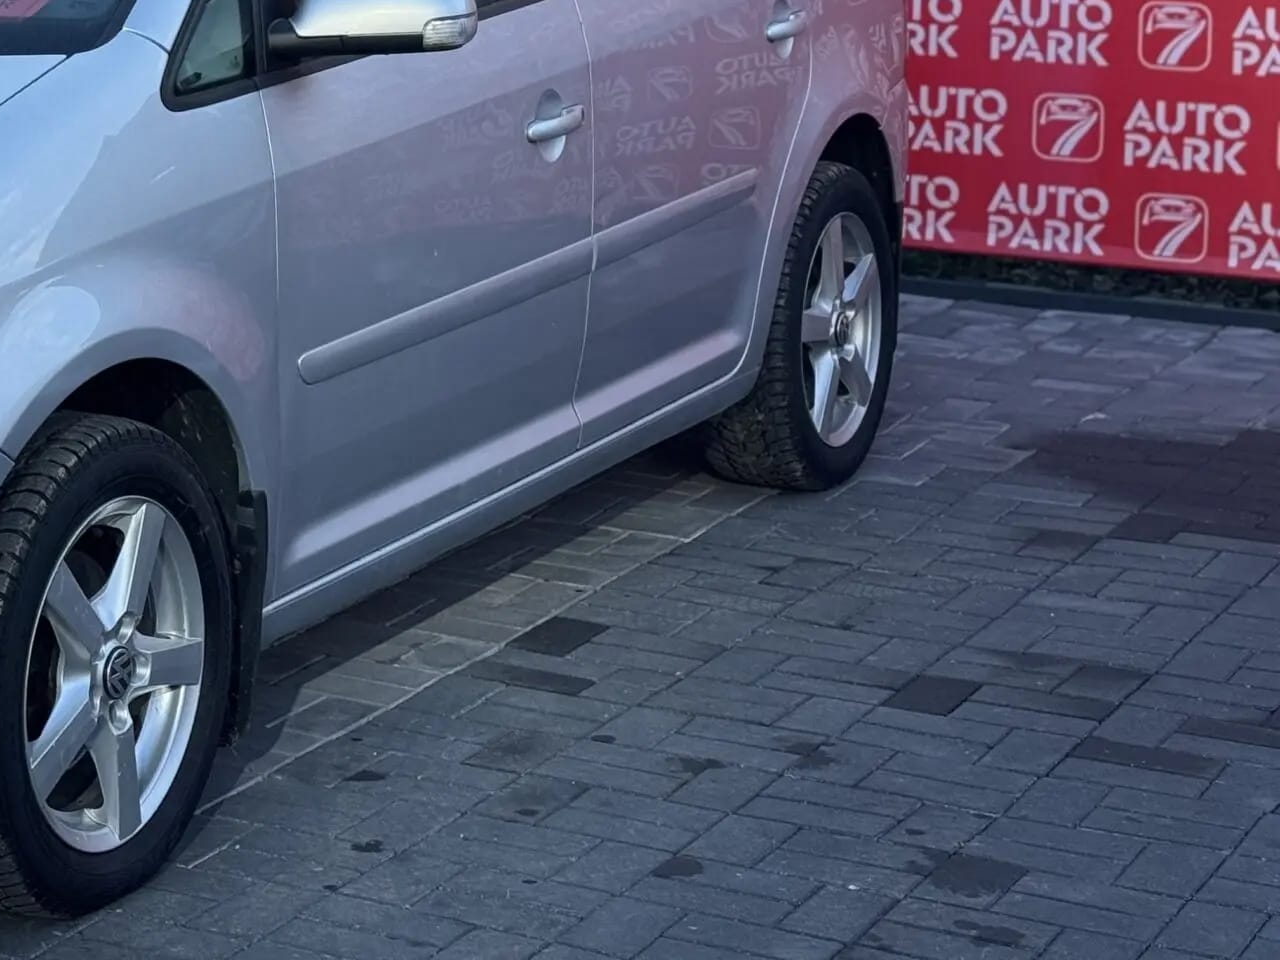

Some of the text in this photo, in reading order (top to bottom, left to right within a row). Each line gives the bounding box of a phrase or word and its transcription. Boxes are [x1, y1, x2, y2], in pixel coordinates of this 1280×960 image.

[990, 29, 1109, 67] PARK
[1232, 39, 1280, 76] PA
[1125, 99, 1251, 139] AUTO
[1124, 135, 1247, 176] PARK
[902, 175, 959, 208] TO
[987, 185, 1109, 220] AUTO
[902, 208, 955, 243] RK
[987, 217, 1105, 256] PARK
[1227, 235, 1280, 272] PA
